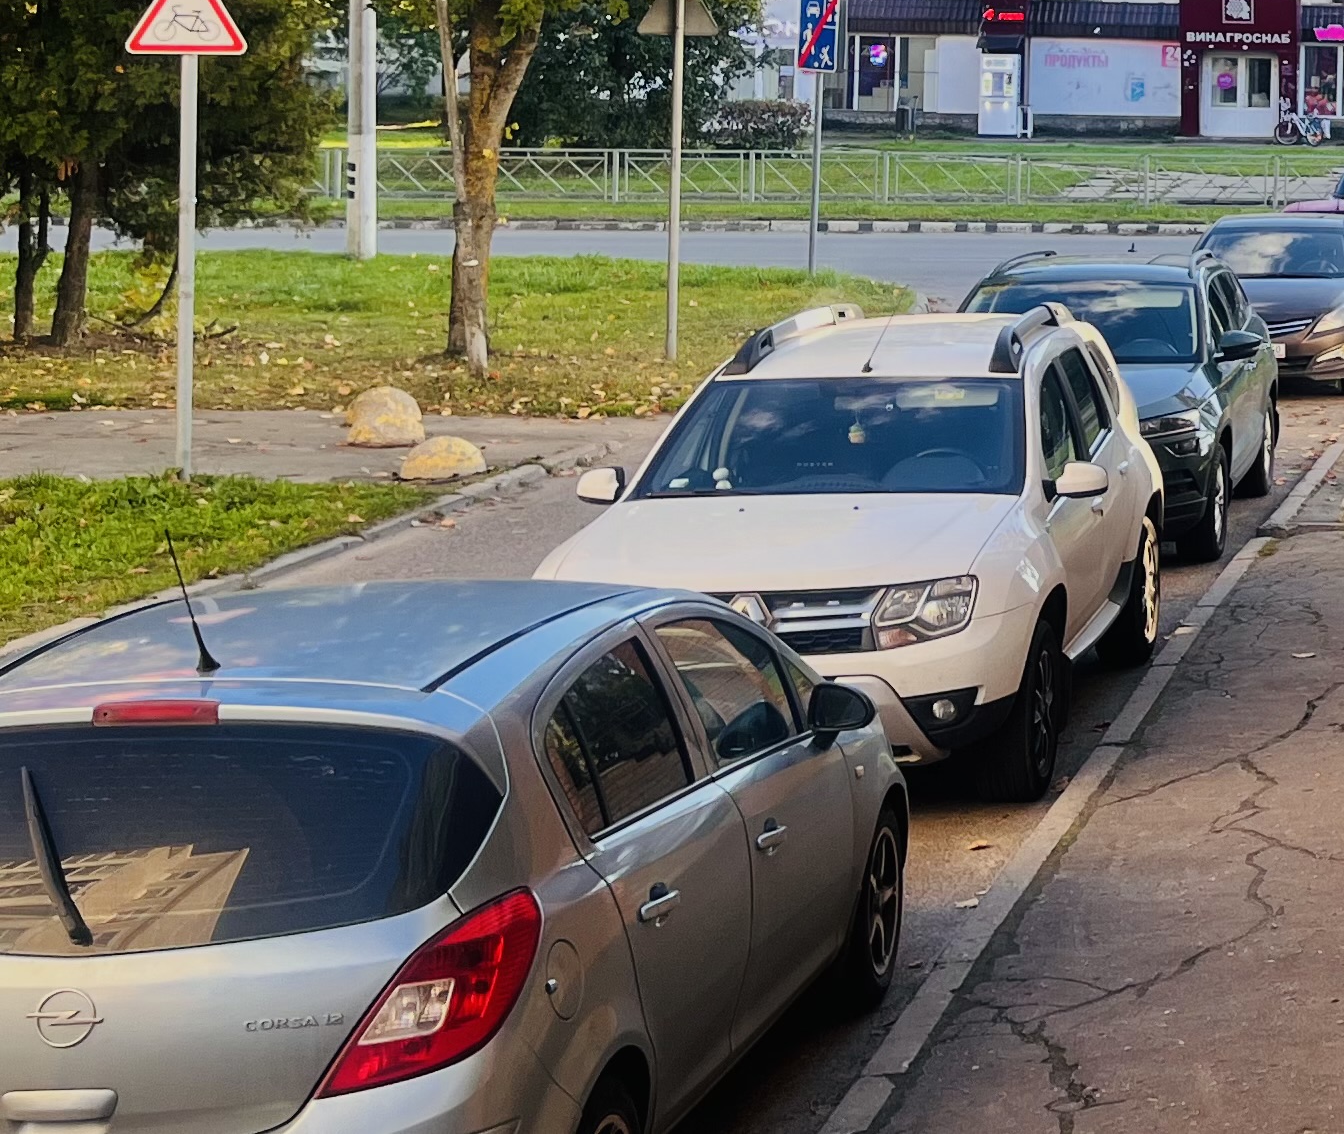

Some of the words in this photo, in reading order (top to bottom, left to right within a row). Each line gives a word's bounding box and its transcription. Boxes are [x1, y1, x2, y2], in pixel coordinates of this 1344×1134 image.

[1186, 31, 1291, 44] ВИНАГРОСНАБ
[1044, 54, 1109, 69] ПРОДУКТЫ
[244, 1015, 319, 1032] CORSA
